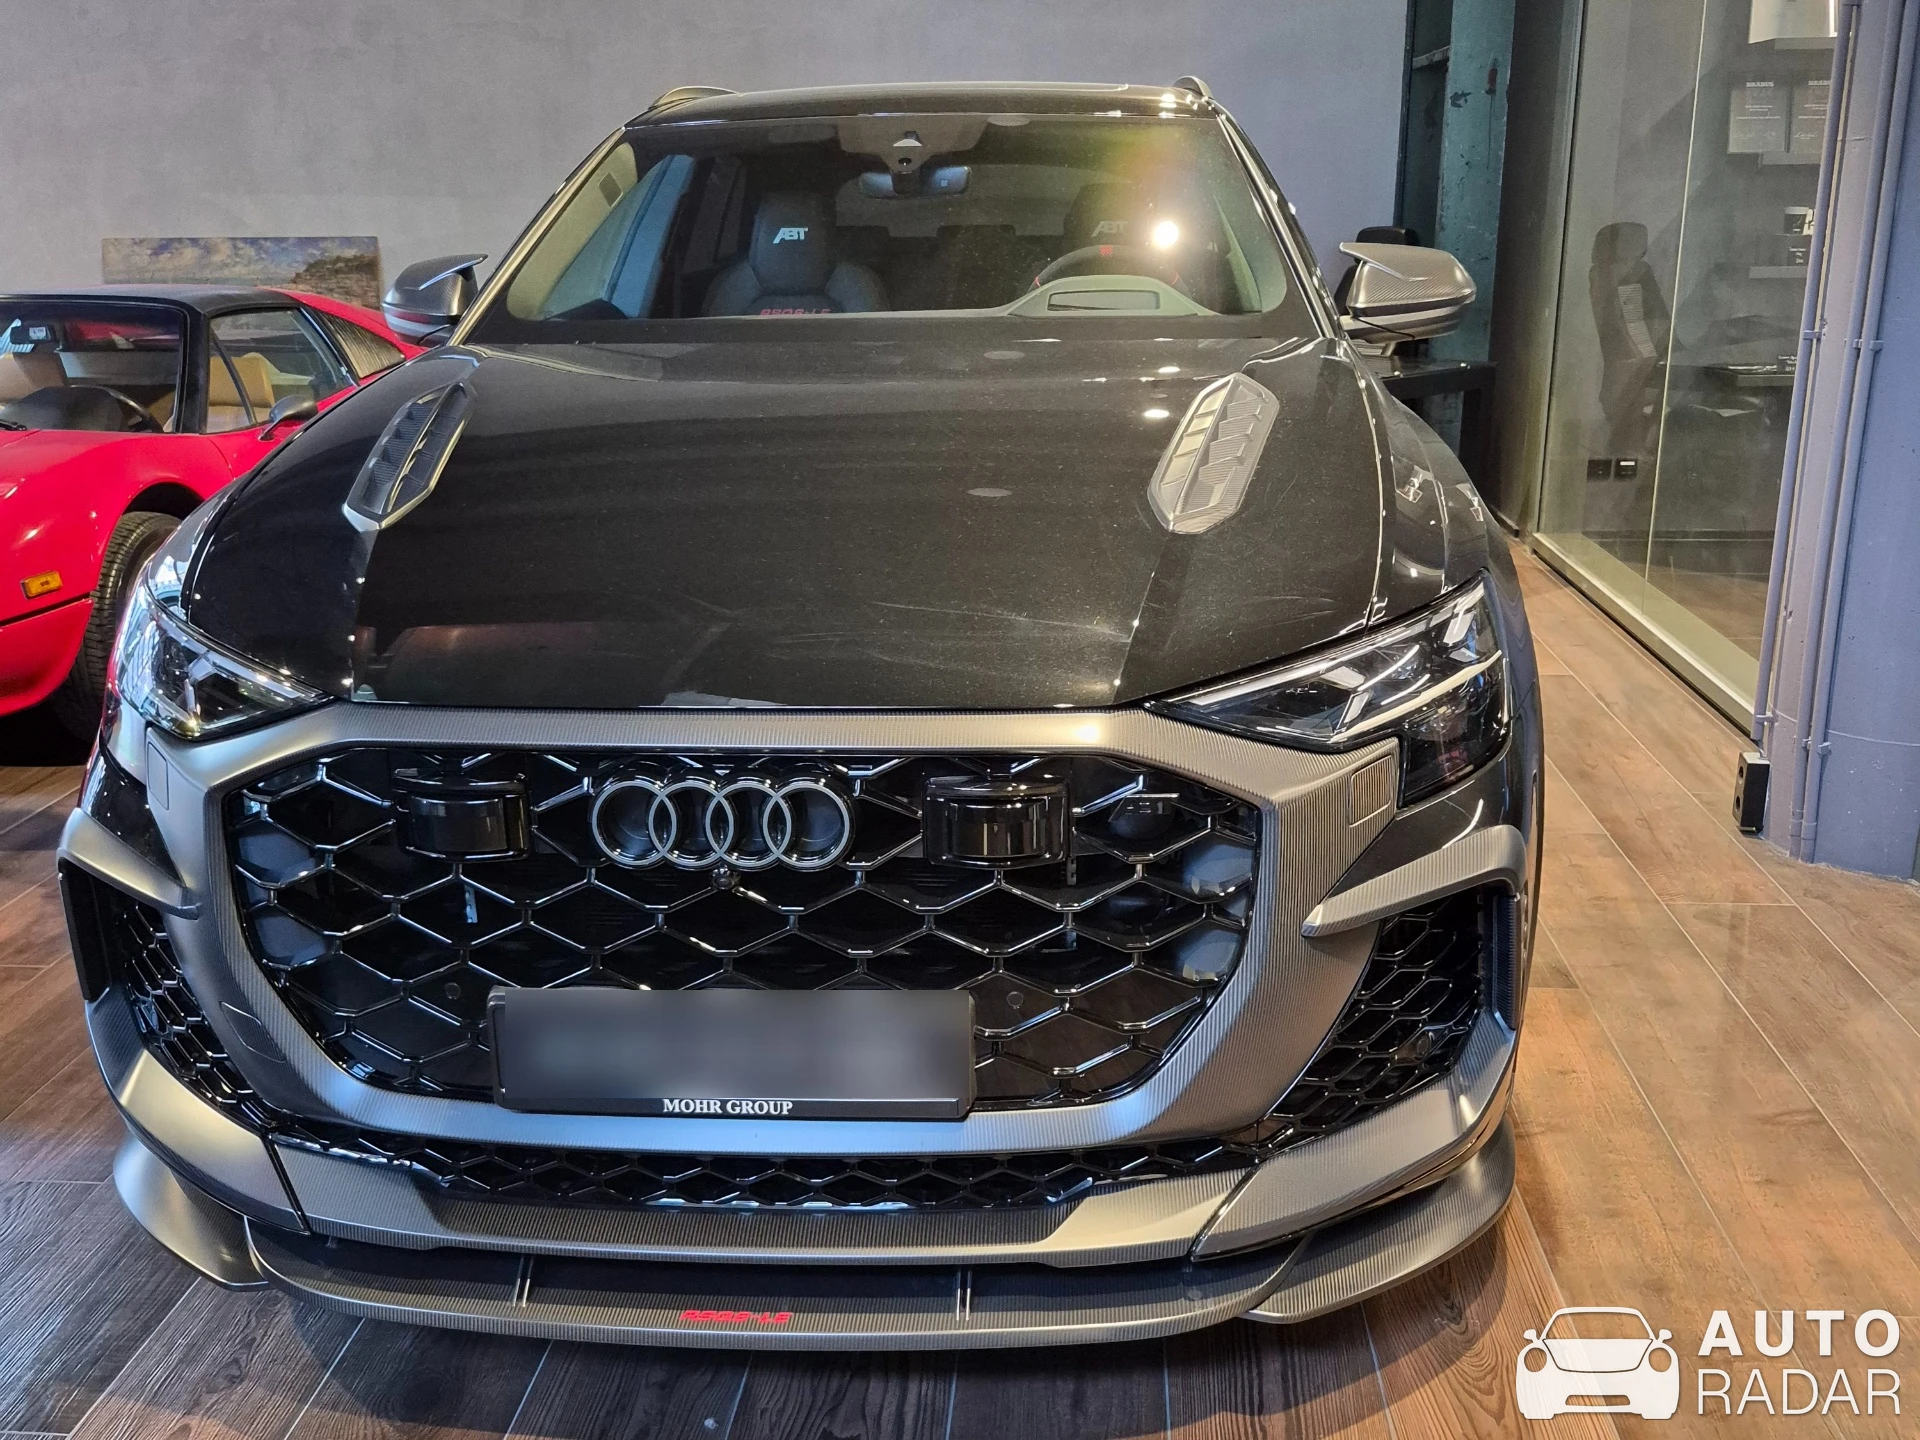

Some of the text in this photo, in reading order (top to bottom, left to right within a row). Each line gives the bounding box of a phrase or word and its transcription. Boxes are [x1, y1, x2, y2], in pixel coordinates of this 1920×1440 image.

[772, 227, 809, 244] ABT
[1091, 220, 1129, 237] ABT
[662, 1098, 793, 1115] MOHR GROUP
